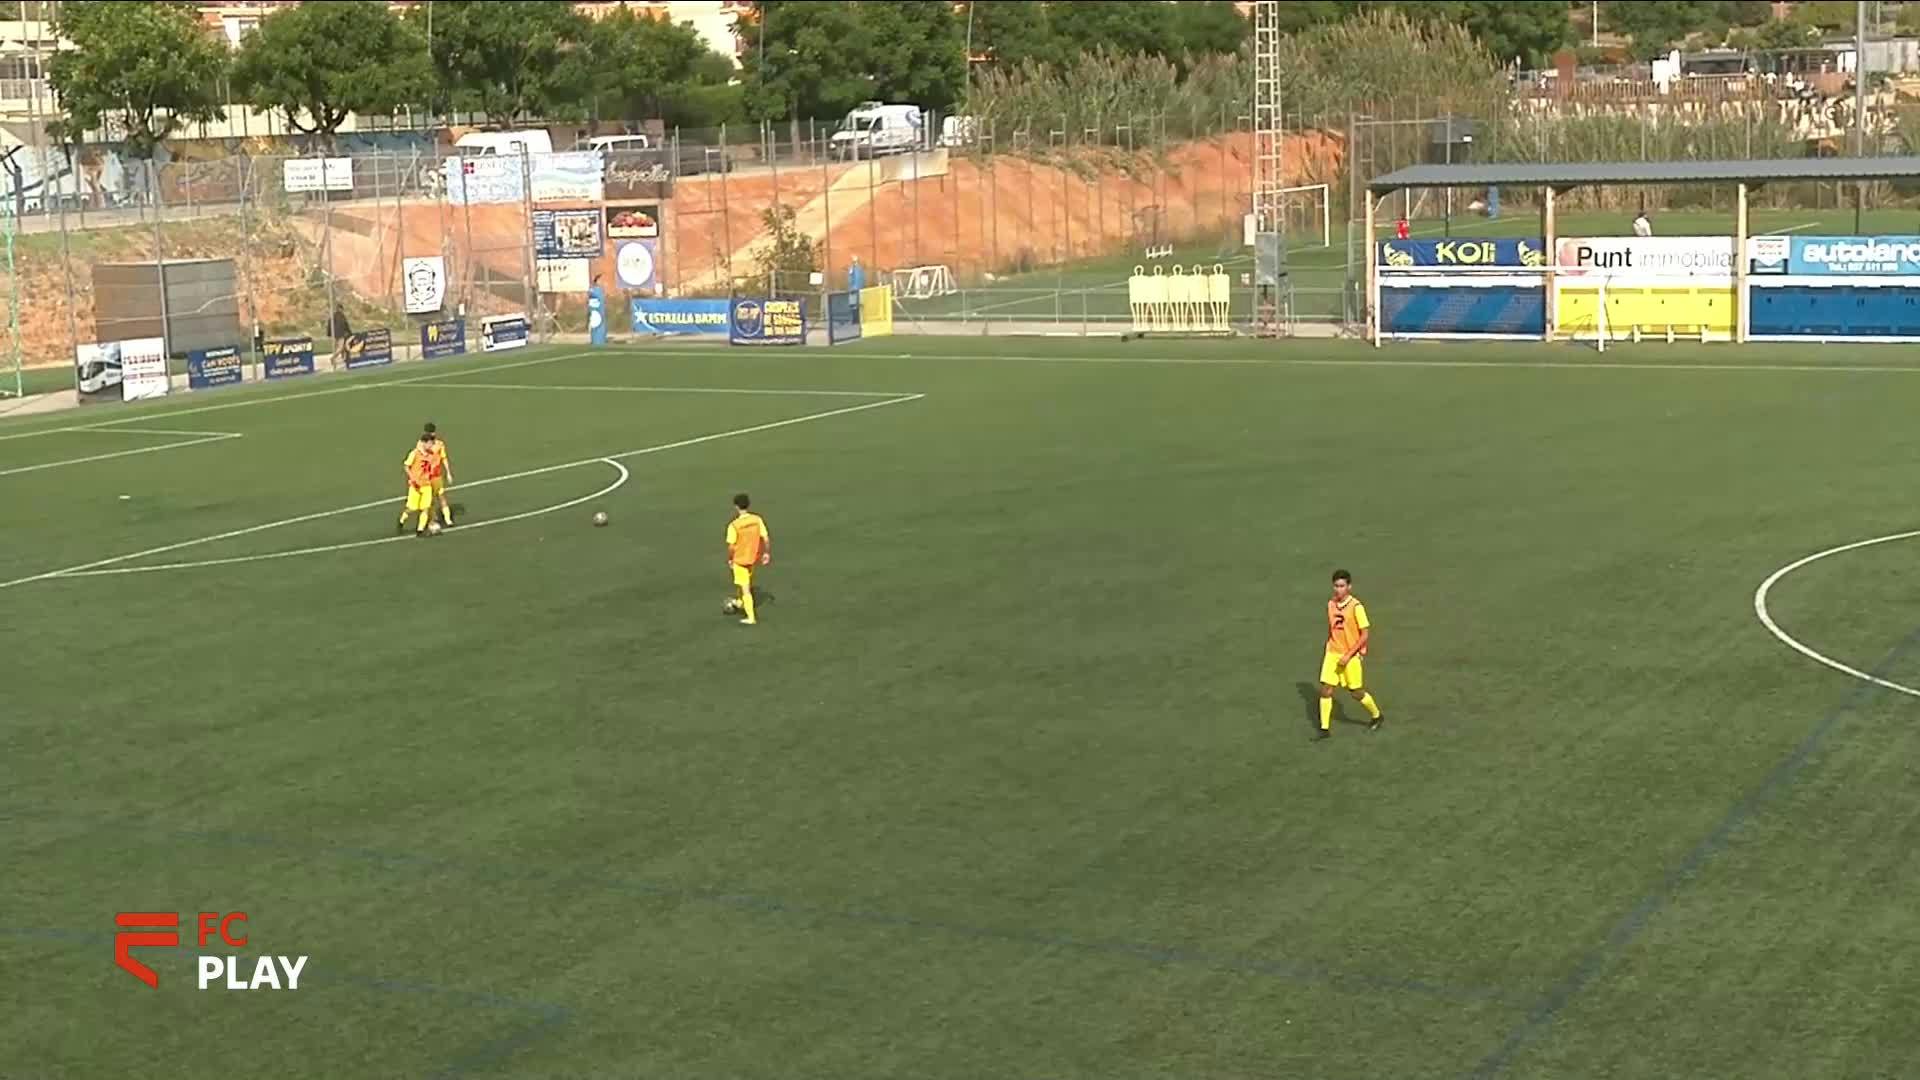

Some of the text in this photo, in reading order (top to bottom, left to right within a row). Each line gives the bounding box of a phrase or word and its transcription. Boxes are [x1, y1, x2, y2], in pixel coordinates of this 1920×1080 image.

[1577, 247, 1632, 268] Punt
[648, 312, 694, 325] ESTRELLA
[694, 312, 728, 325] DAMM
[282, 342, 313, 354] SPORTS
[1333, 614, 1345, 630] 2
